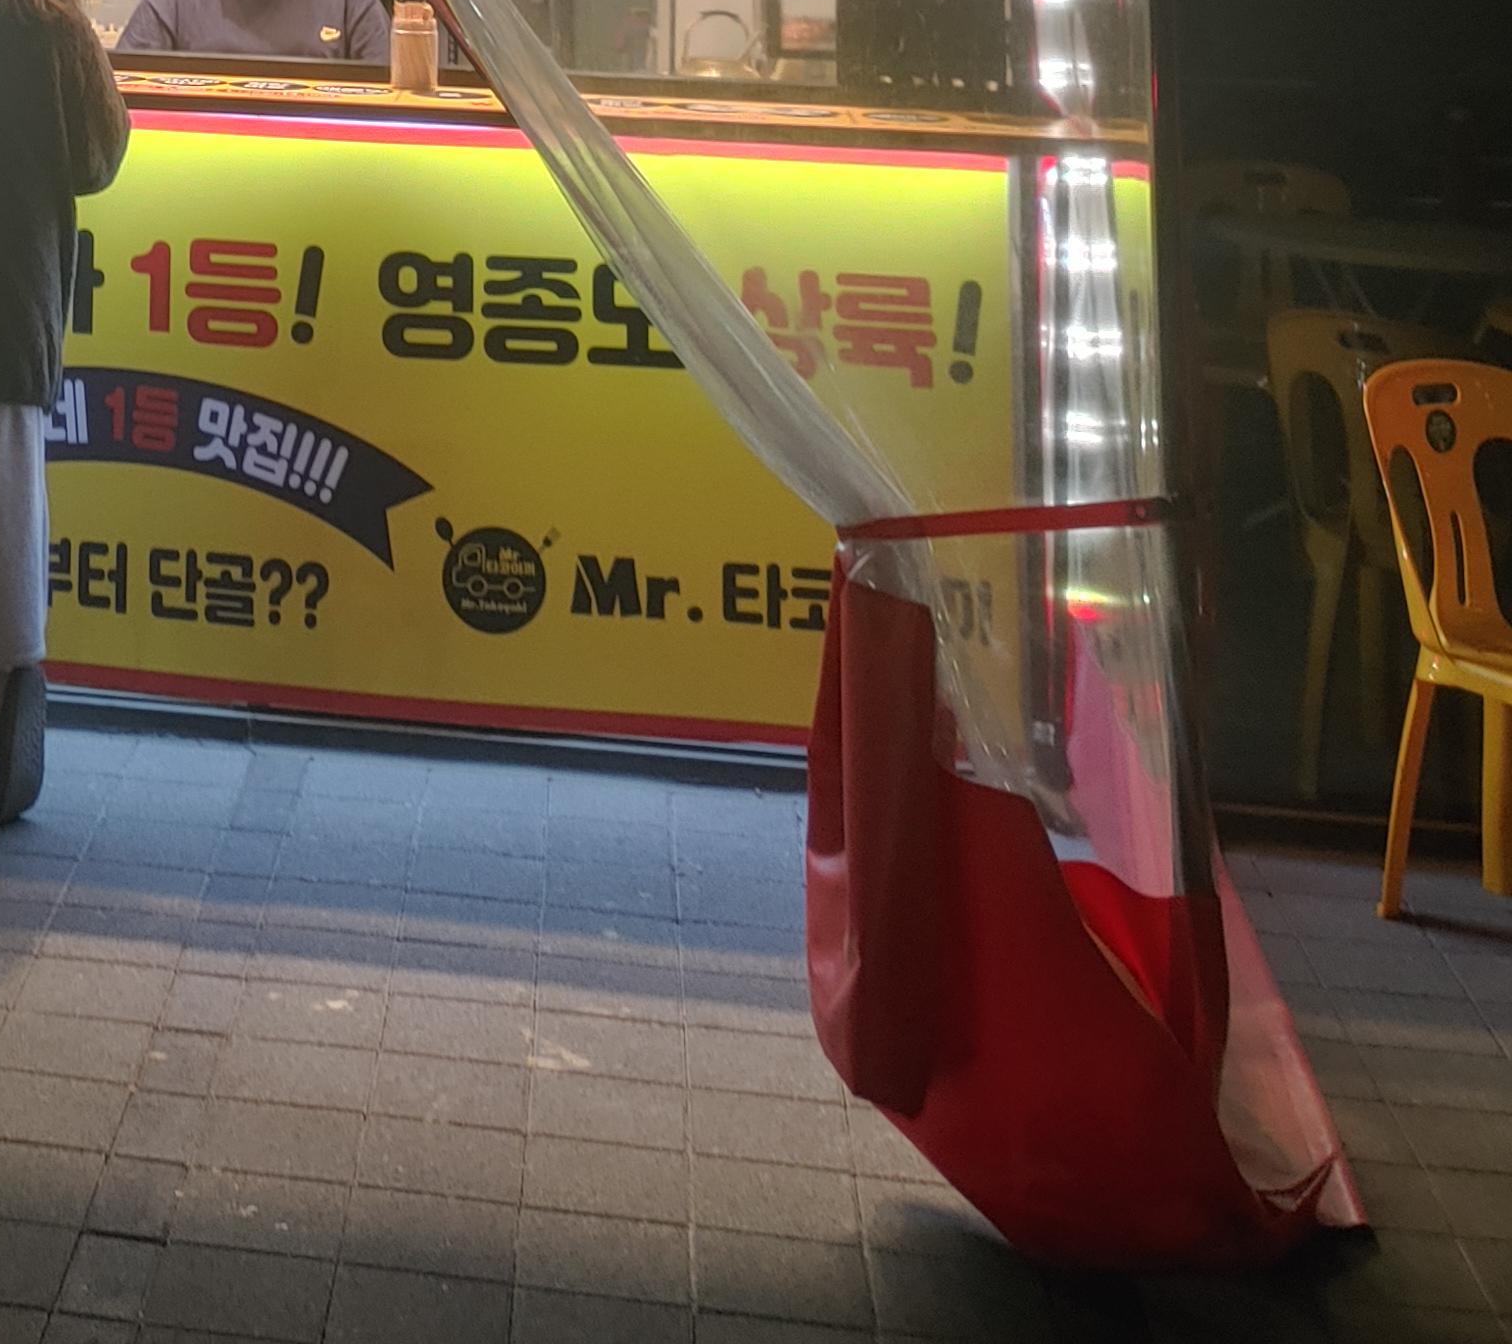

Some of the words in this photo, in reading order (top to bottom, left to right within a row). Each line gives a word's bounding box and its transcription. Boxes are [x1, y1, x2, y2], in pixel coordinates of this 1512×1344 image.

[129, 238, 325, 348] 1등!
[104, 384, 180, 453] 1등
[193, 397, 350, 505] 맛집!!!
[48, 536, 129, 615] 부터
[148, 547, 330, 630] 단골??
[570, 553, 705, 623] Mr.
